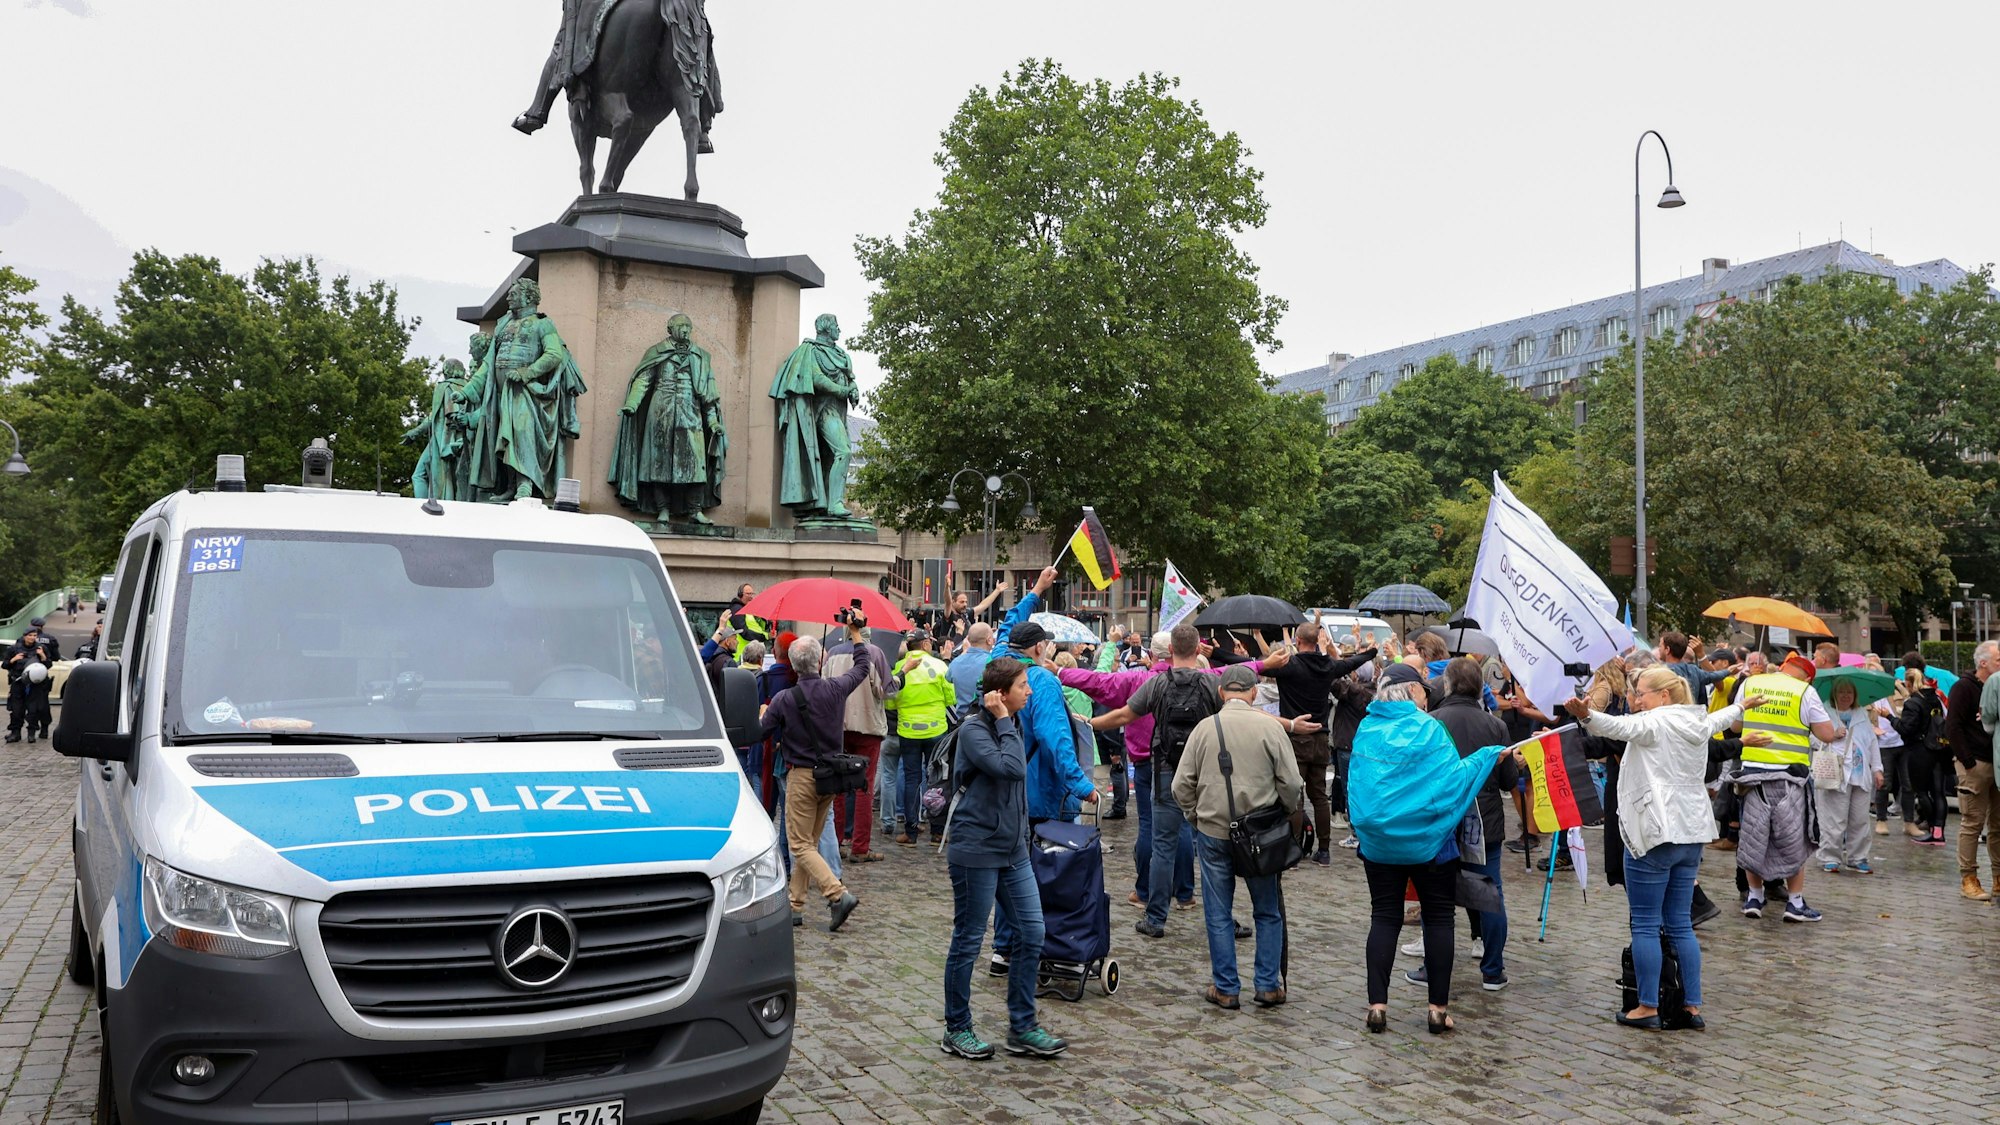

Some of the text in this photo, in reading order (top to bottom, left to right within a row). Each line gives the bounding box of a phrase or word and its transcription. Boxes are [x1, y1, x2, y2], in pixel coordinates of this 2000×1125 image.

[194, 536, 242, 549] NRW
[201, 547, 232, 560] 311
[192, 559, 236, 572] BeSi
[1500, 554, 1590, 654] QUERDENKEN
[1763, 688, 1775, 696] bin
[1775, 690, 1794, 698] nicht
[353, 785, 652, 825] POLIZEI
